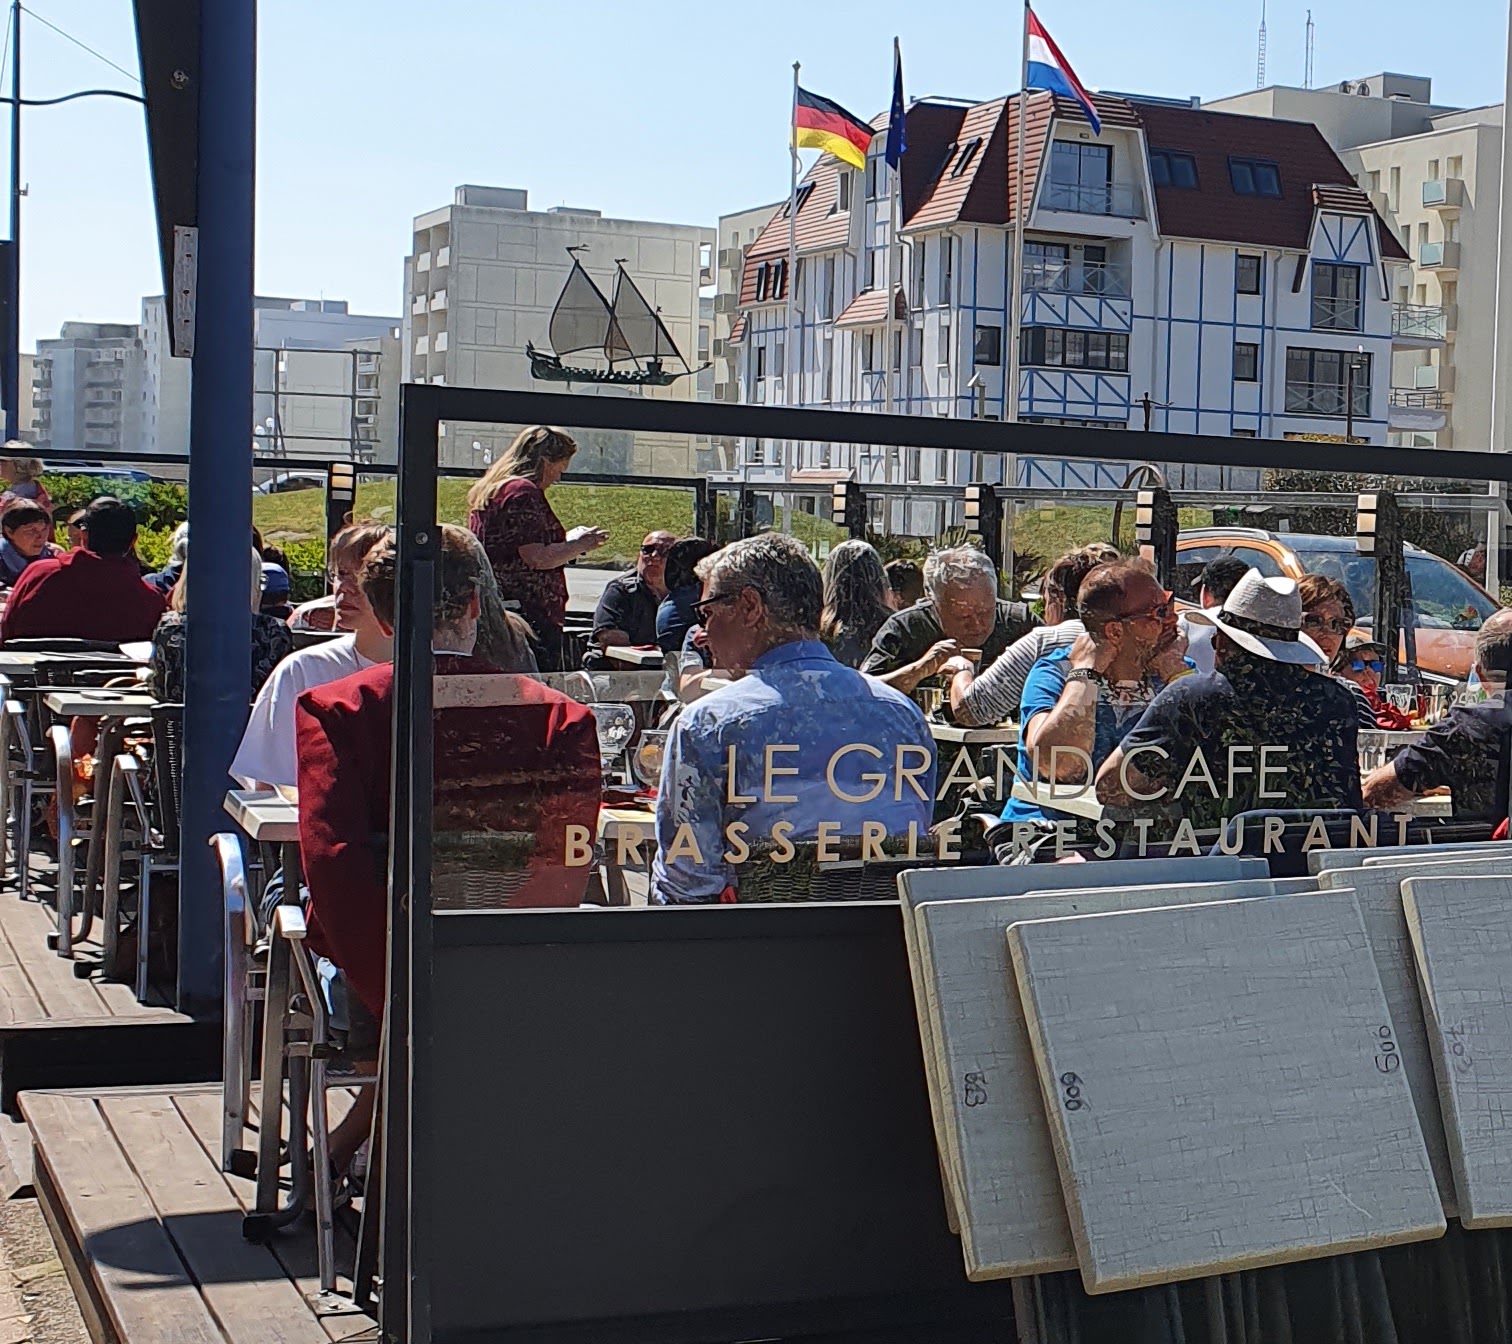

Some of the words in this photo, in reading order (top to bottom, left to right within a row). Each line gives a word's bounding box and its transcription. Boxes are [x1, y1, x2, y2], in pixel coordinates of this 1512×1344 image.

[727, 743, 800, 804] LE
[826, 743, 1095, 803] GRAND
[1119, 743, 1288, 802] CAFE
[565, 819, 962, 867] BRASSERIE
[1011, 813, 1414, 859] RESTAURANT
